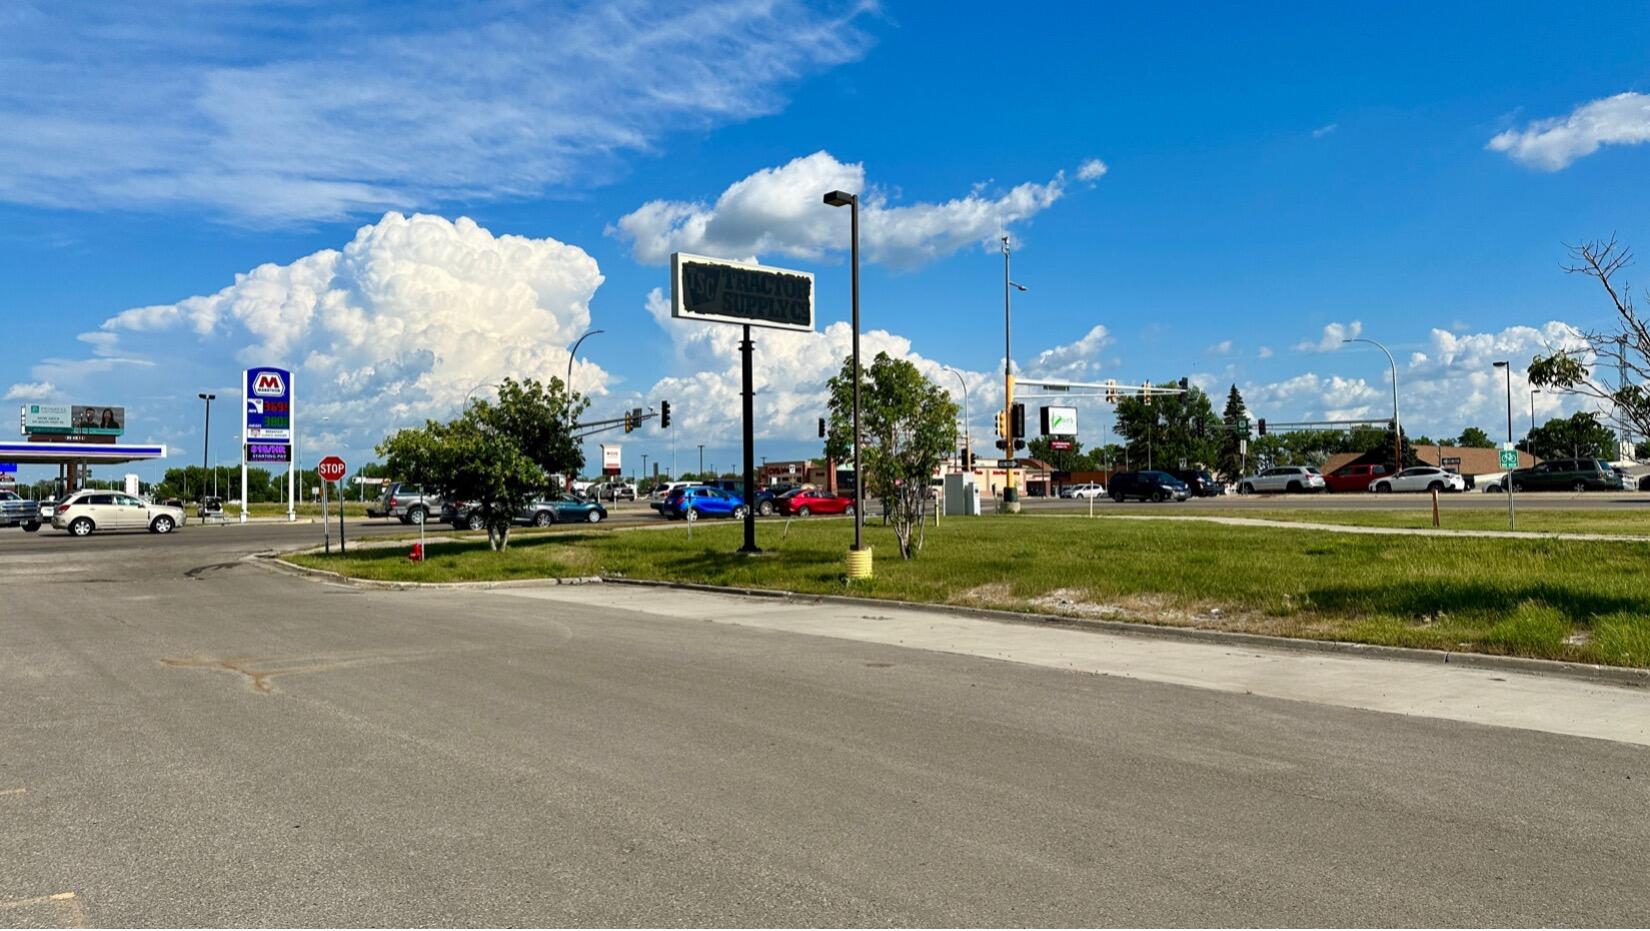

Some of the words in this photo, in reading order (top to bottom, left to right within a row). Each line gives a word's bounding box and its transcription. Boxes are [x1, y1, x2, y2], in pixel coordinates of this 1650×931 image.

[723, 271, 810, 300] TRACTOR
[722, 291, 790, 319] SUPPLY
[259, 376, 279, 388] M
[320, 463, 345, 474] STOP
